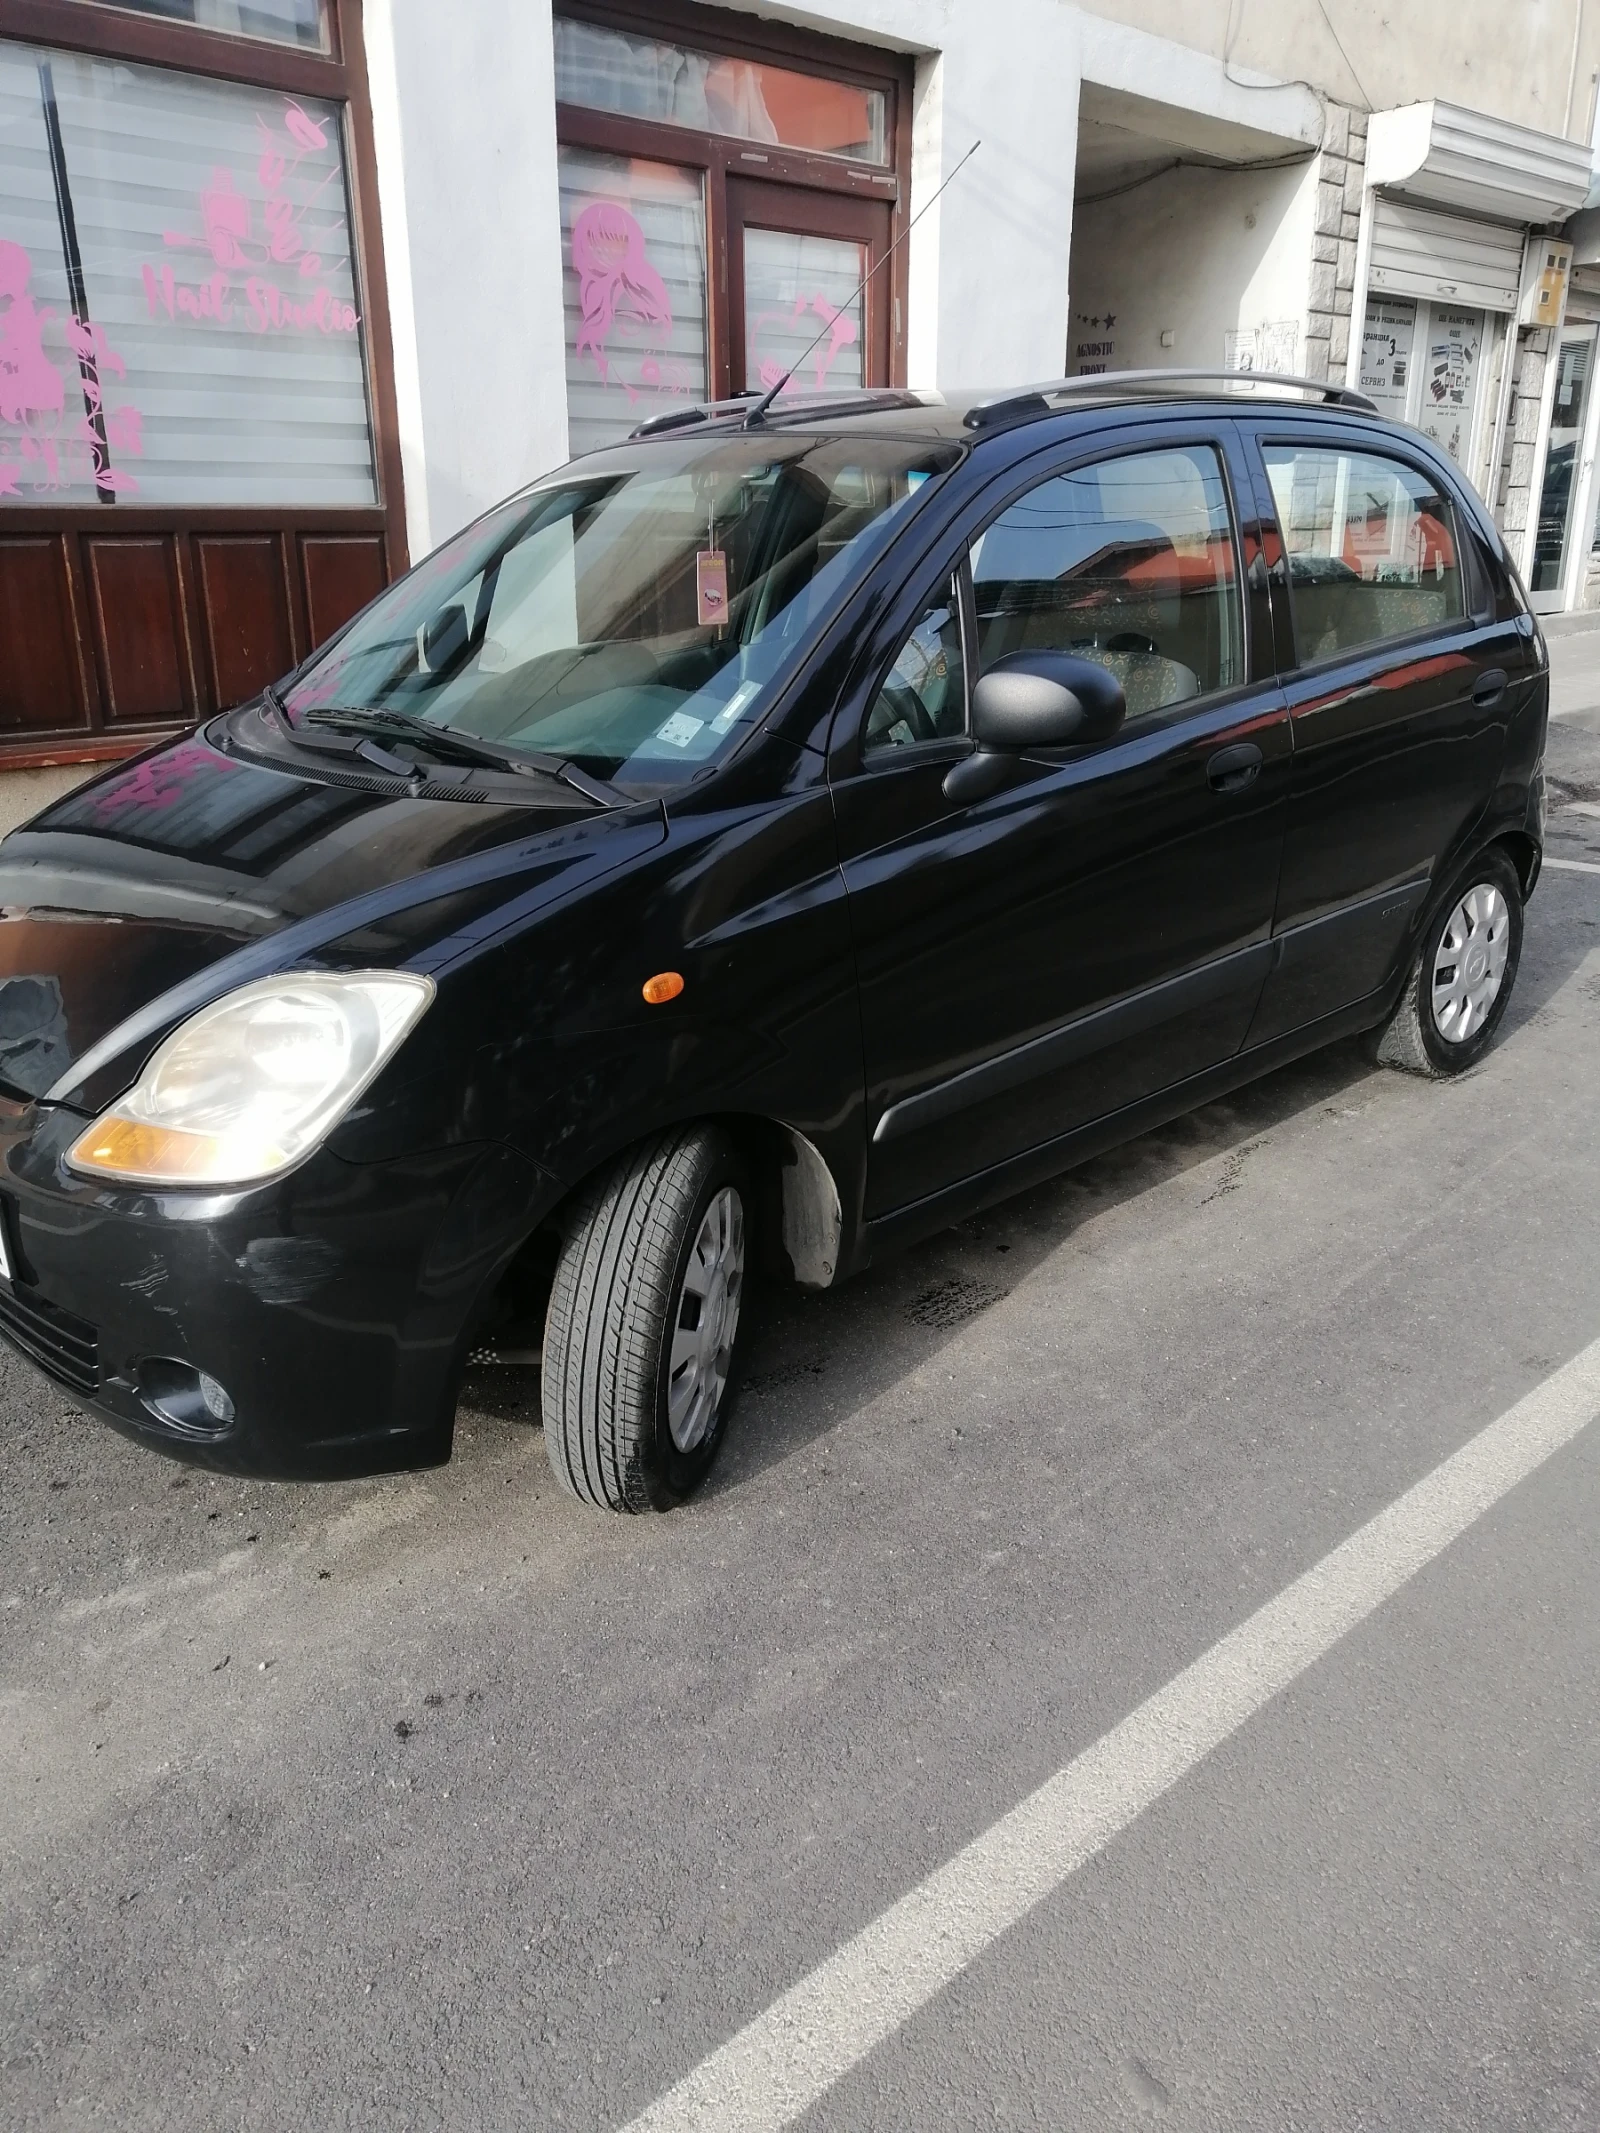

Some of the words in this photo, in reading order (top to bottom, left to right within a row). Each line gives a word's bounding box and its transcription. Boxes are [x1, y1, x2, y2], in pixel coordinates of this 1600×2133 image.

[141, 263, 234, 323] Nail
[245, 275, 362, 334] Studio
[1075, 341, 1115, 358] AGNOSTIC
[1387, 338, 1397, 357] 3
[1079, 363, 1106, 376] FRONT
[1360, 376, 1386, 387] СЕРВИЗ
